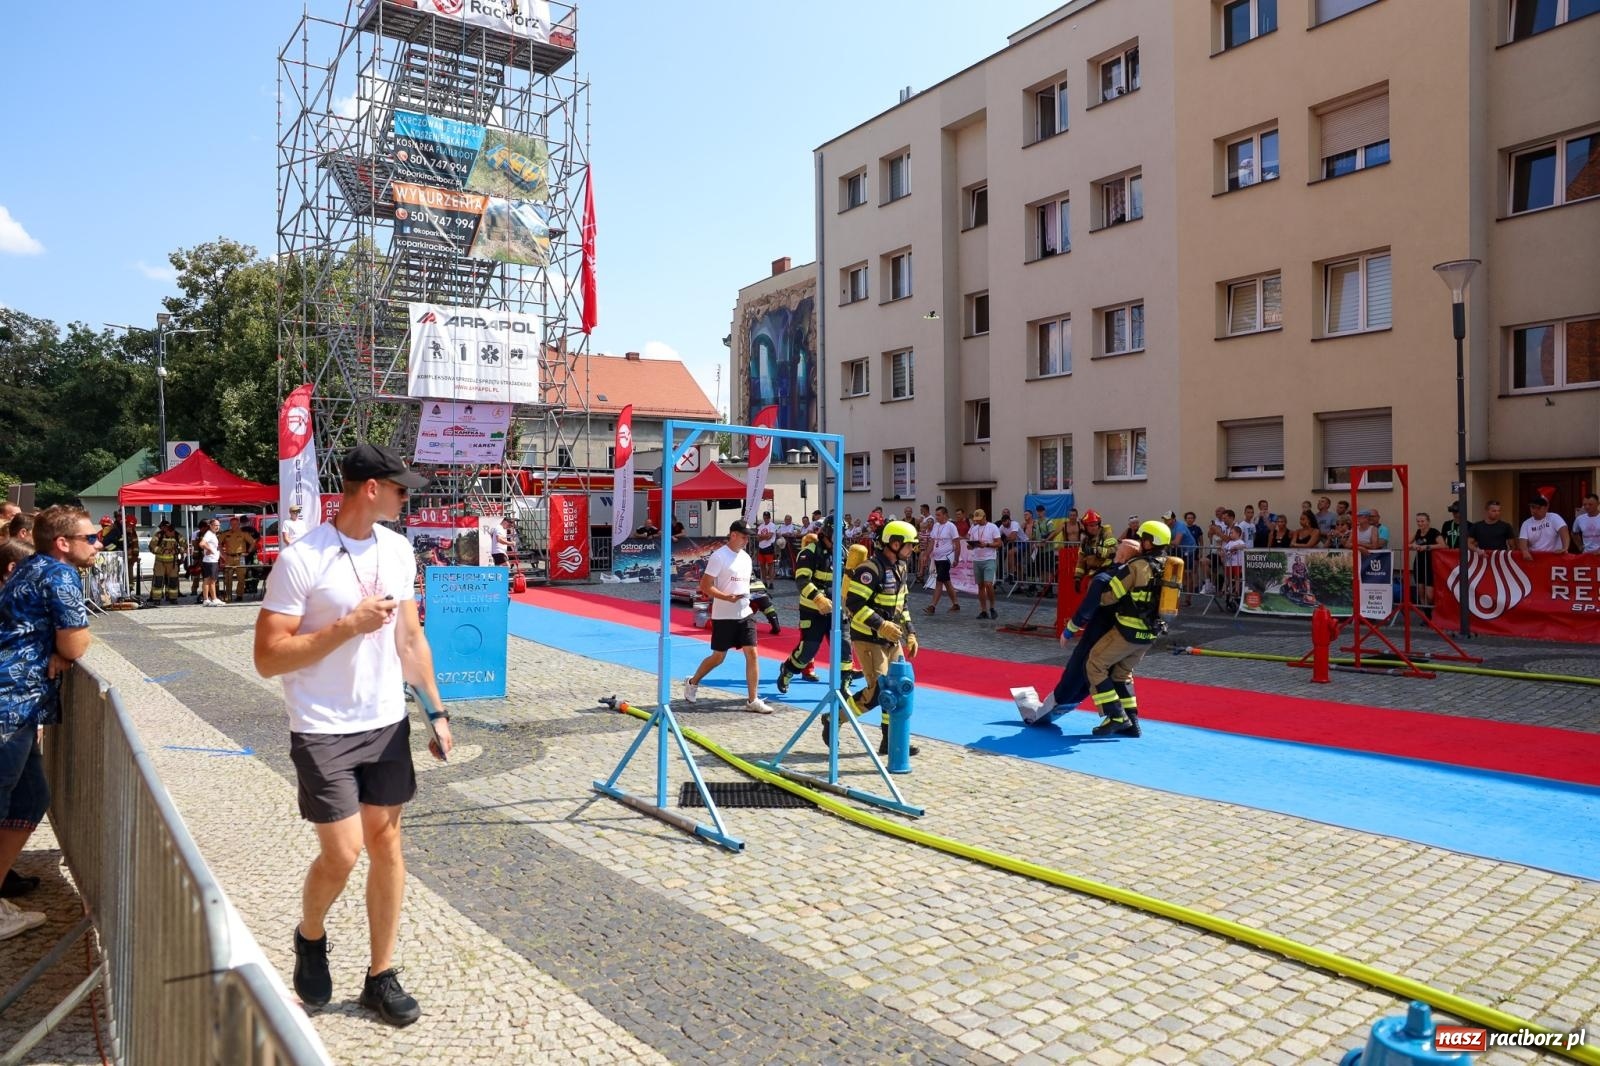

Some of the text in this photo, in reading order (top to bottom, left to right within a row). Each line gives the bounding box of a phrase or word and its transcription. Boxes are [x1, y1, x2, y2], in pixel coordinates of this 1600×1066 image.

[410, 154, 467, 174] 501 747 994
[396, 186, 482, 210] WYBURZENIA
[410, 211, 474, 229] 501 747 994
[444, 315, 535, 334] ARPAPOL
[432, 573, 502, 582] FIREFIGHTER
[1551, 566, 1600, 582] RE
[441, 584, 488, 592] COMBAT
